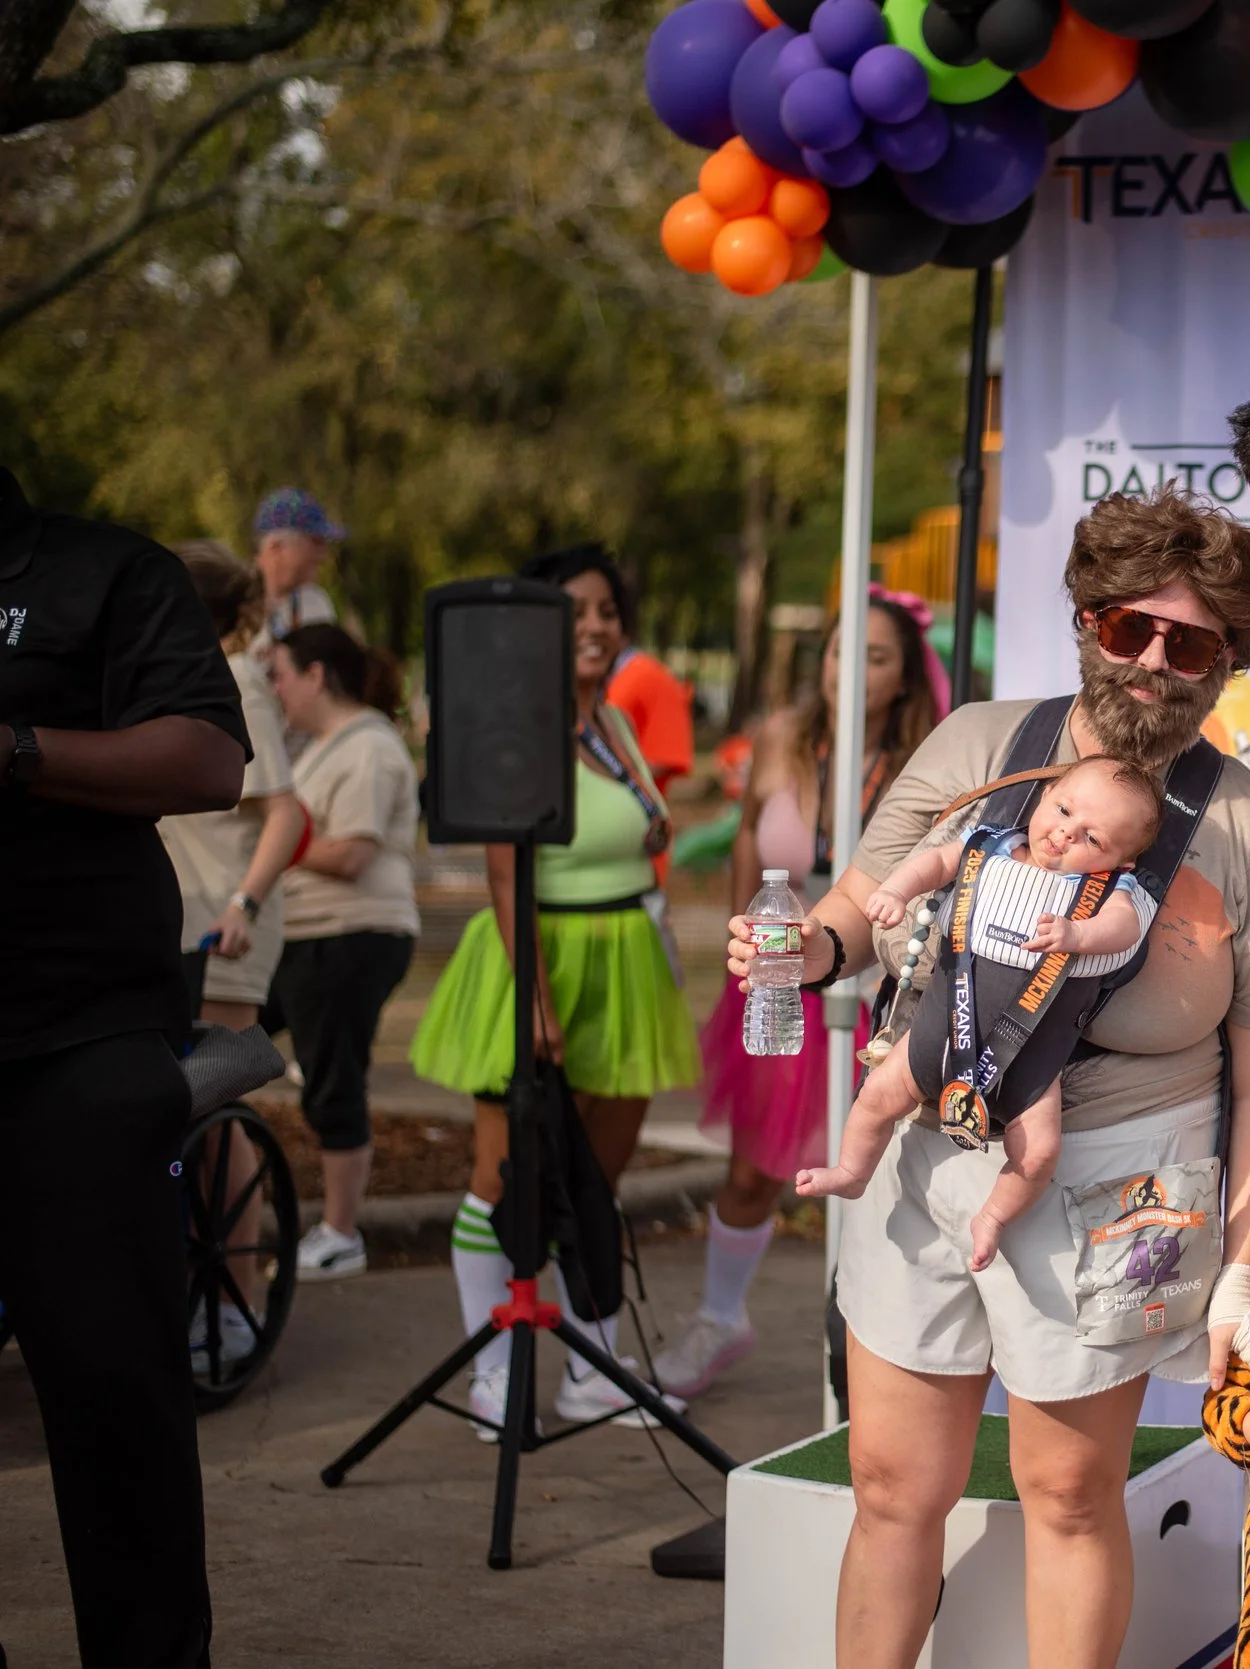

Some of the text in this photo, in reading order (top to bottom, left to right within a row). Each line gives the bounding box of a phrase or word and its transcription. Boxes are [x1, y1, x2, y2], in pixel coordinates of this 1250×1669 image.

[1053, 152, 1250, 224] TEXA
[1085, 440, 1117, 455] THE
[952, 848, 986, 953] 2025 FINISHER
[1018, 874, 1106, 1014] MCKINN ONSTER
[955, 972, 971, 1050] TEXANS
[977, 1064, 998, 1096] ALLS
[1126, 1236, 1180, 1287] 42
[1113, 1290, 1149, 1303] TRINITY
[1114, 1300, 1141, 1311] FALLS
[1161, 1278, 1202, 1298] TEXANS
